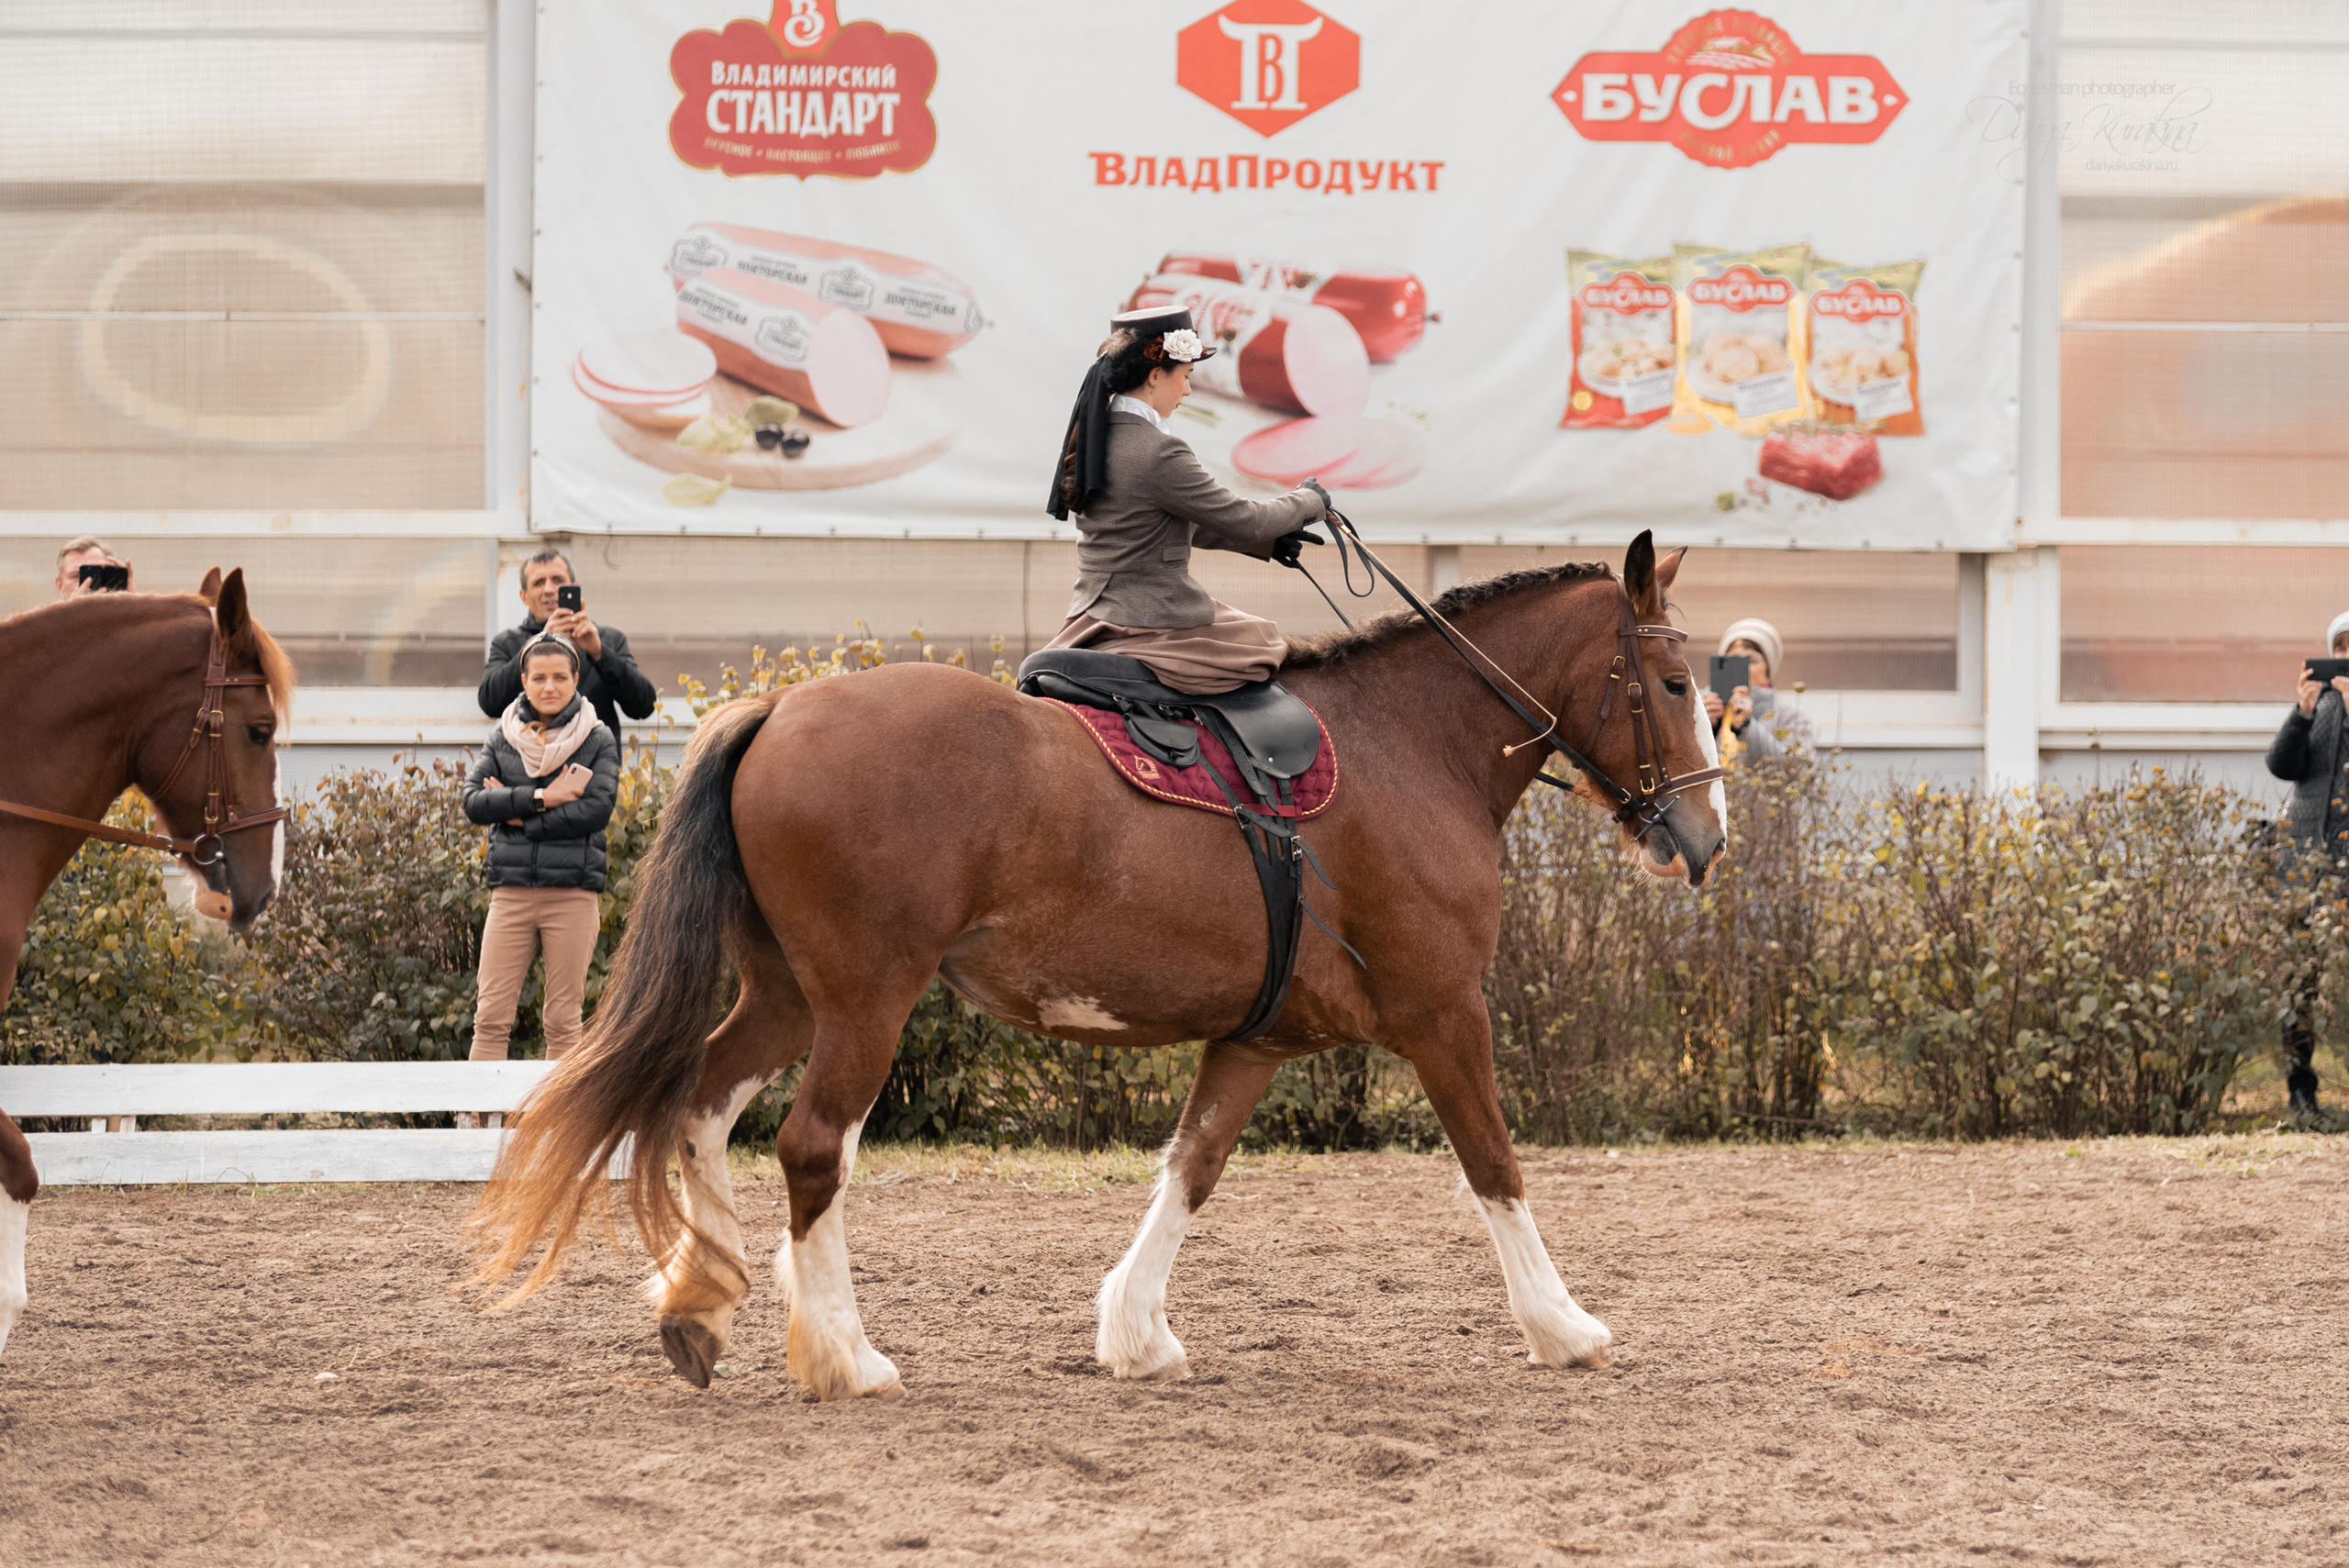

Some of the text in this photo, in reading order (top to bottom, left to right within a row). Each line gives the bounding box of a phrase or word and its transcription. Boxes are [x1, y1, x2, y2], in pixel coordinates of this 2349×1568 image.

[711, 61, 896, 87] ВЛАДИМИРСКИЙ
[1582, 72, 1879, 130] БУСЛАВ
[706, 89, 900, 139] СТАНДАРТ
[1586, 287, 1667, 306] БУСЛАВ
[1693, 284, 1787, 304] БУСЛАВ
[1817, 296, 1901, 314] БУСЛАВ
